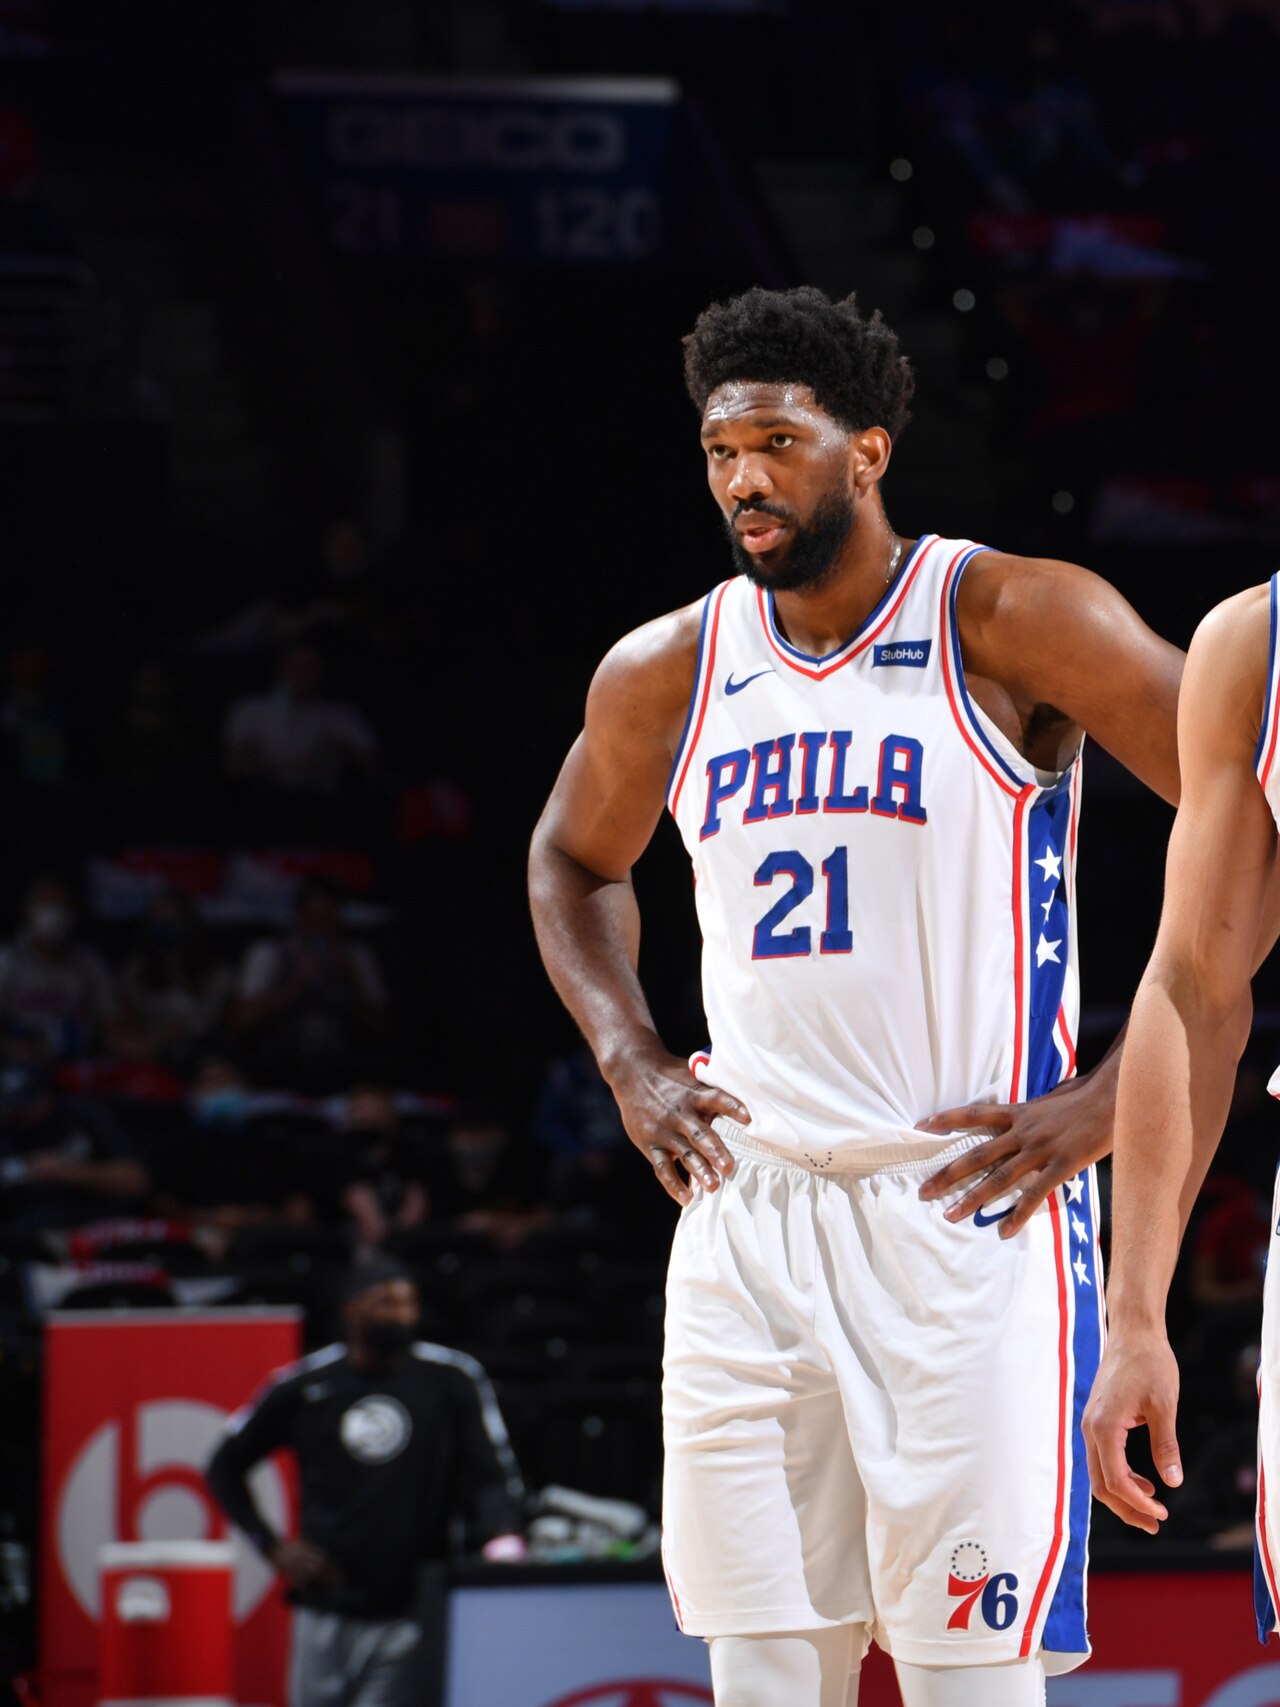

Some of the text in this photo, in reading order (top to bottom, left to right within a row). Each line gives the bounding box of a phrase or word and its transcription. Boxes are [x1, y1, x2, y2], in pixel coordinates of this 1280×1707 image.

[881, 648, 924, 661] StubHub
[699, 730, 928, 843] PHILA
[751, 846, 853, 960] 21
[947, 1572, 1019, 1631] 76
